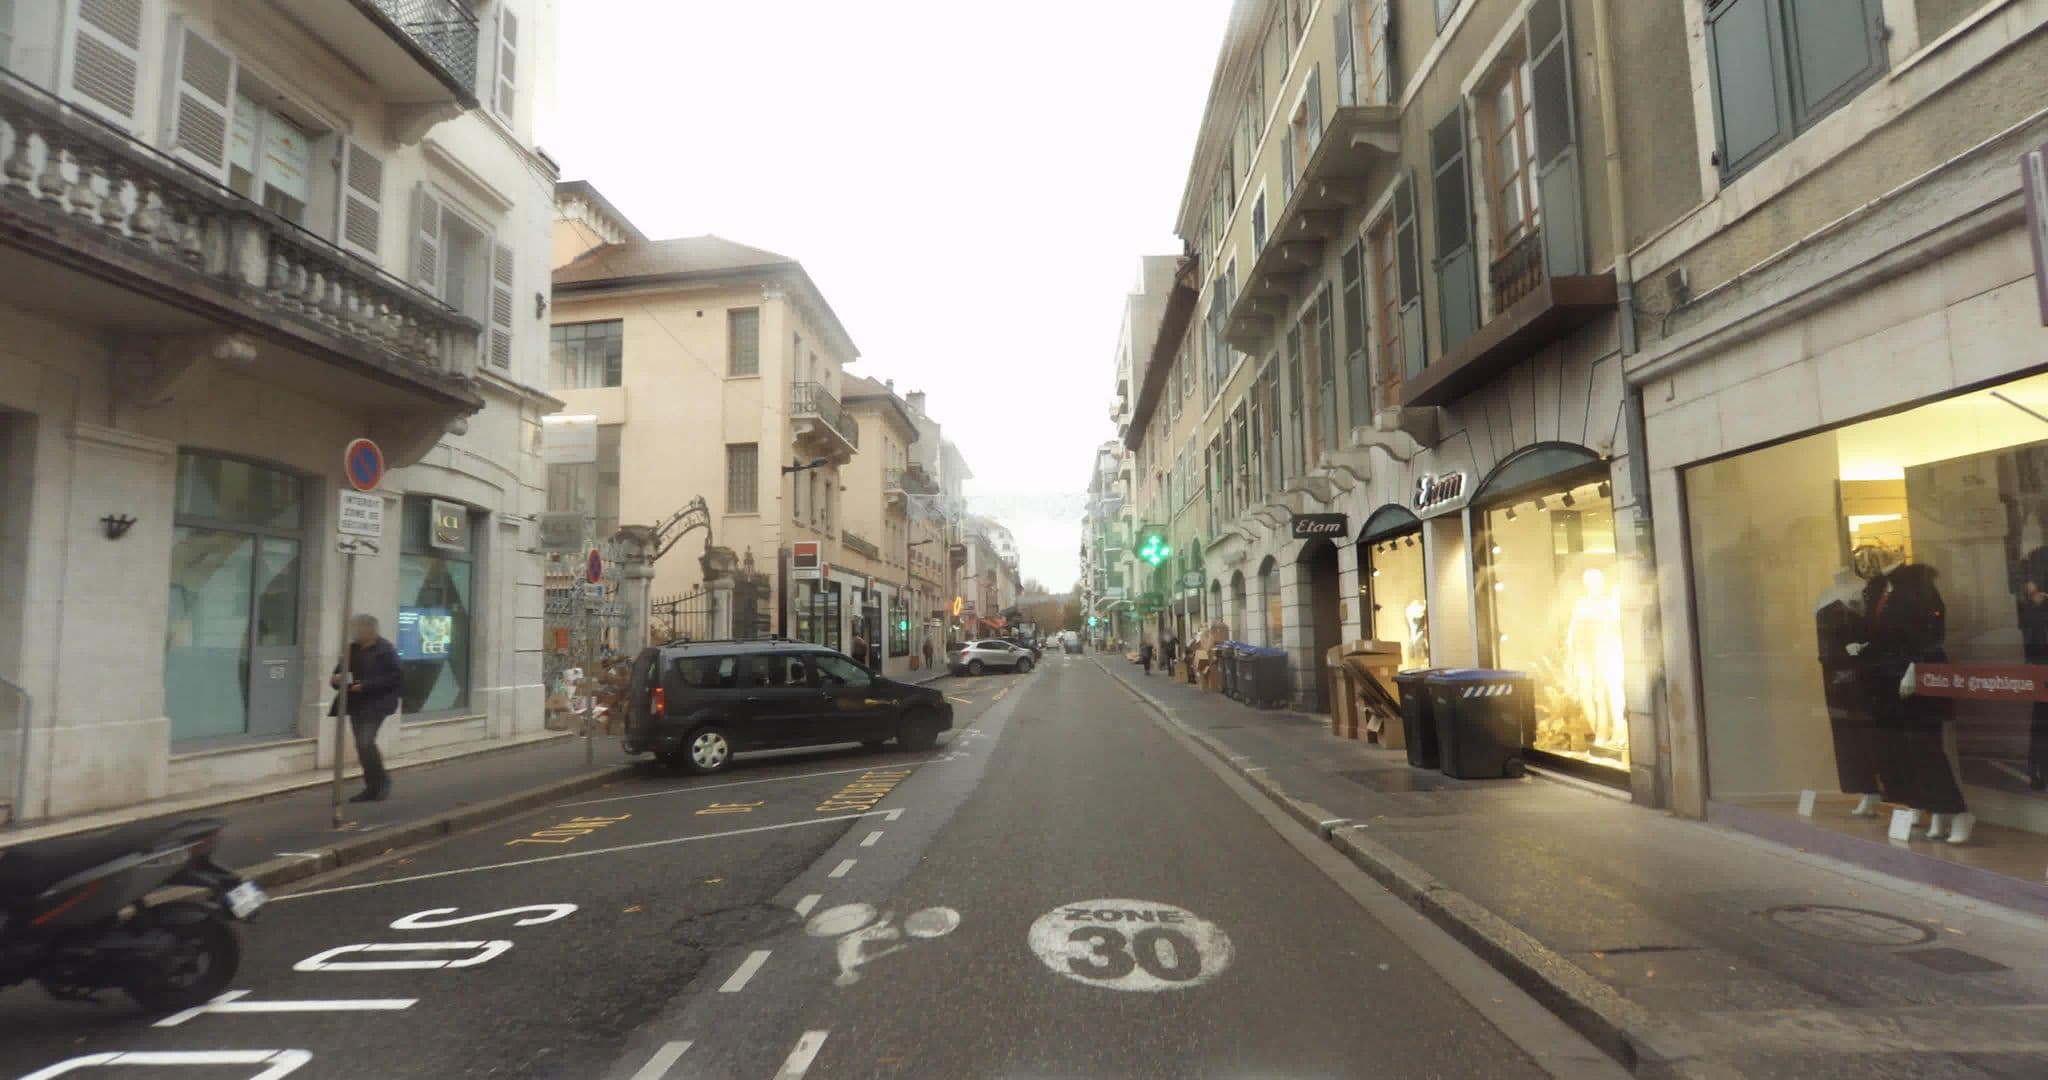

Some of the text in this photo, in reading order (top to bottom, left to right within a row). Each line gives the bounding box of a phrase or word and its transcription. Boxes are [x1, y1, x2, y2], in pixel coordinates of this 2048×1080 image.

[1295, 518, 1341, 534] Etam
[1923, 673, 2034, 693] Chic & graphique
[1064, 908, 1190, 923] ZONE
[1067, 925, 1203, 982] 30
